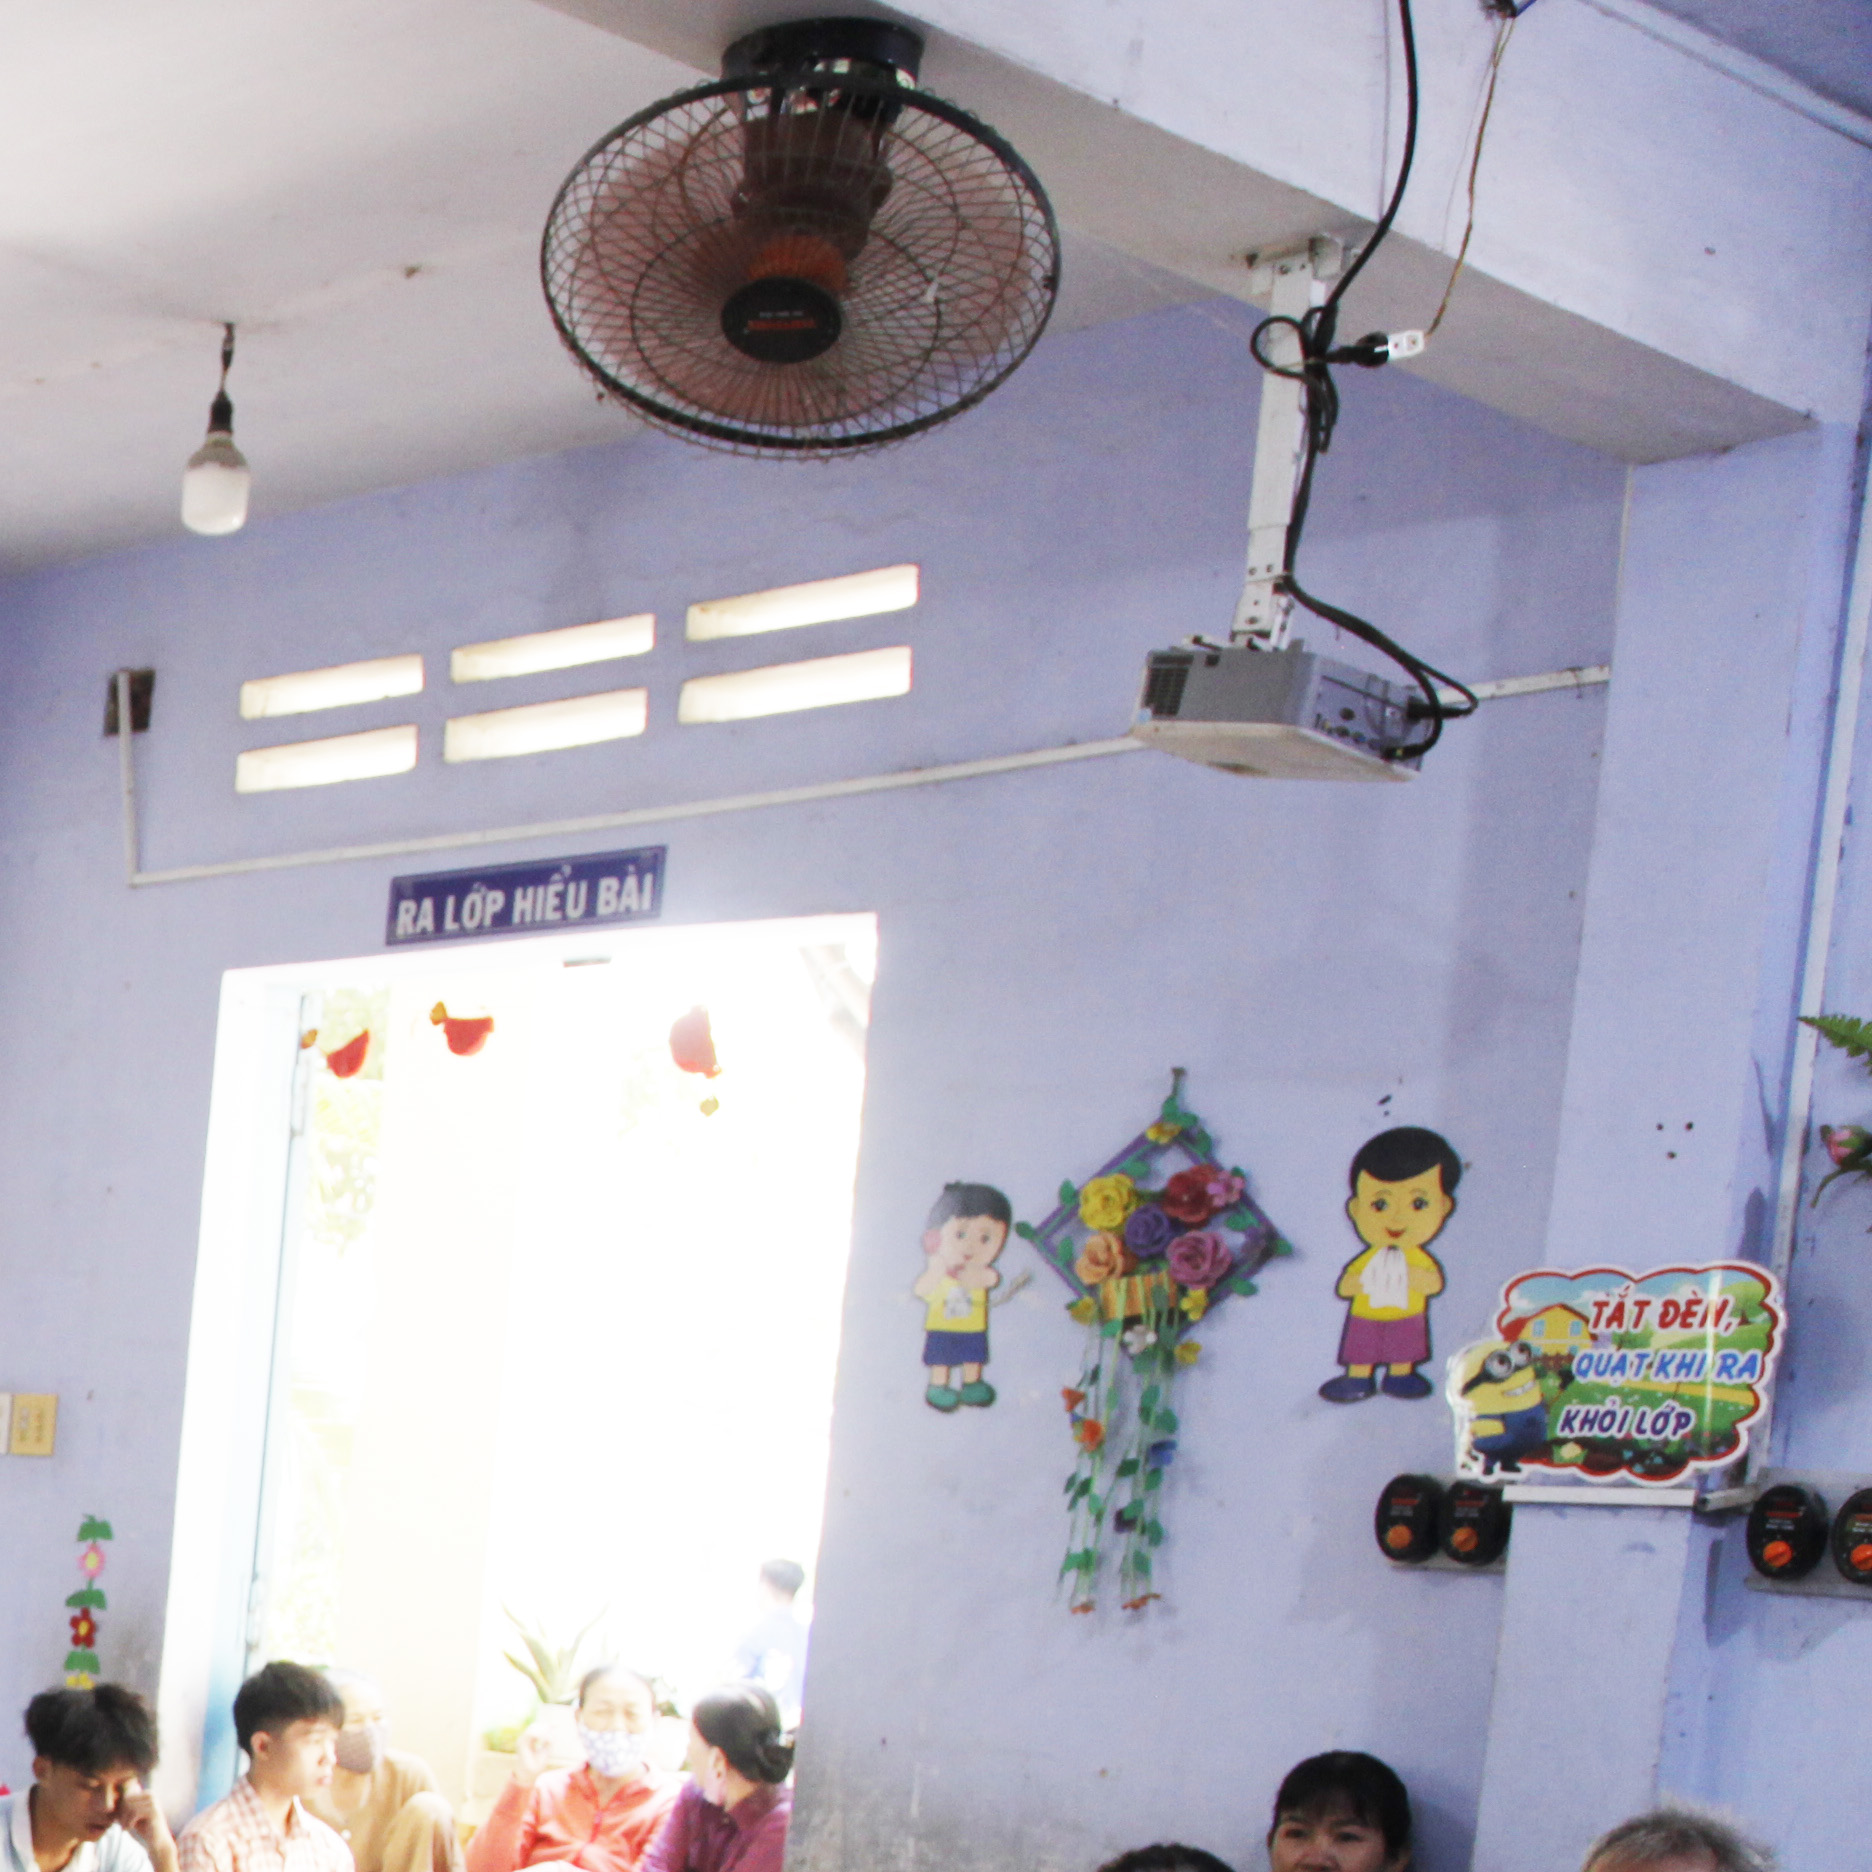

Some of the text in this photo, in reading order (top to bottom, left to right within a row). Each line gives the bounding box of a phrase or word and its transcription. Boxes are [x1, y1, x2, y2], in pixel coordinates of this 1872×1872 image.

[396, 897, 435, 937] RA
[1589, 1284, 1651, 1332] TẮT
[1575, 1352, 1758, 1387] QUẠT KHI RA
[1560, 1397, 1692, 1437] KHỎI LỚP
